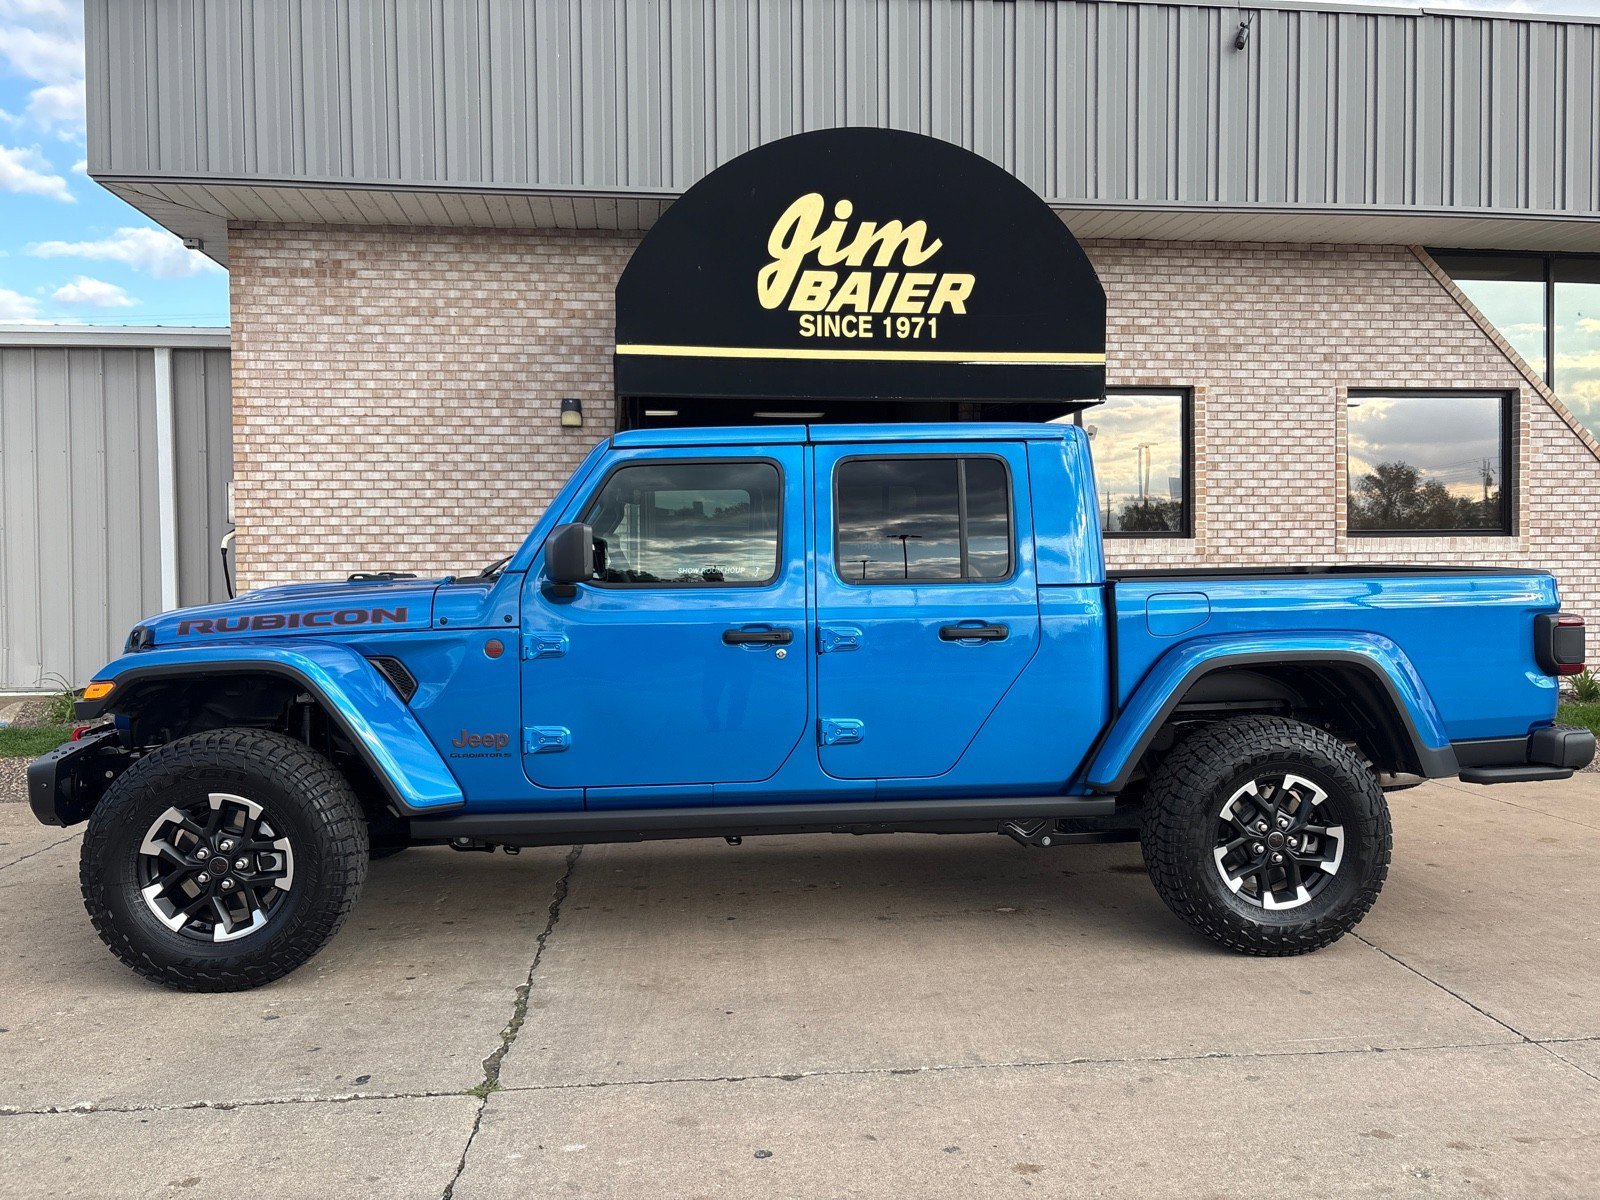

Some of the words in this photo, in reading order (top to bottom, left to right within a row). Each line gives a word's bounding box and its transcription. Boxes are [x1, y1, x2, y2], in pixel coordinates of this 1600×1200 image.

[757, 192, 943, 311] Jim
[787, 269, 977, 315] BAIER
[798, 314, 873, 338] SINCE
[882, 316, 938, 339] 1971
[176, 607, 408, 636] RUBICON
[452, 729, 509, 750] Jeep
